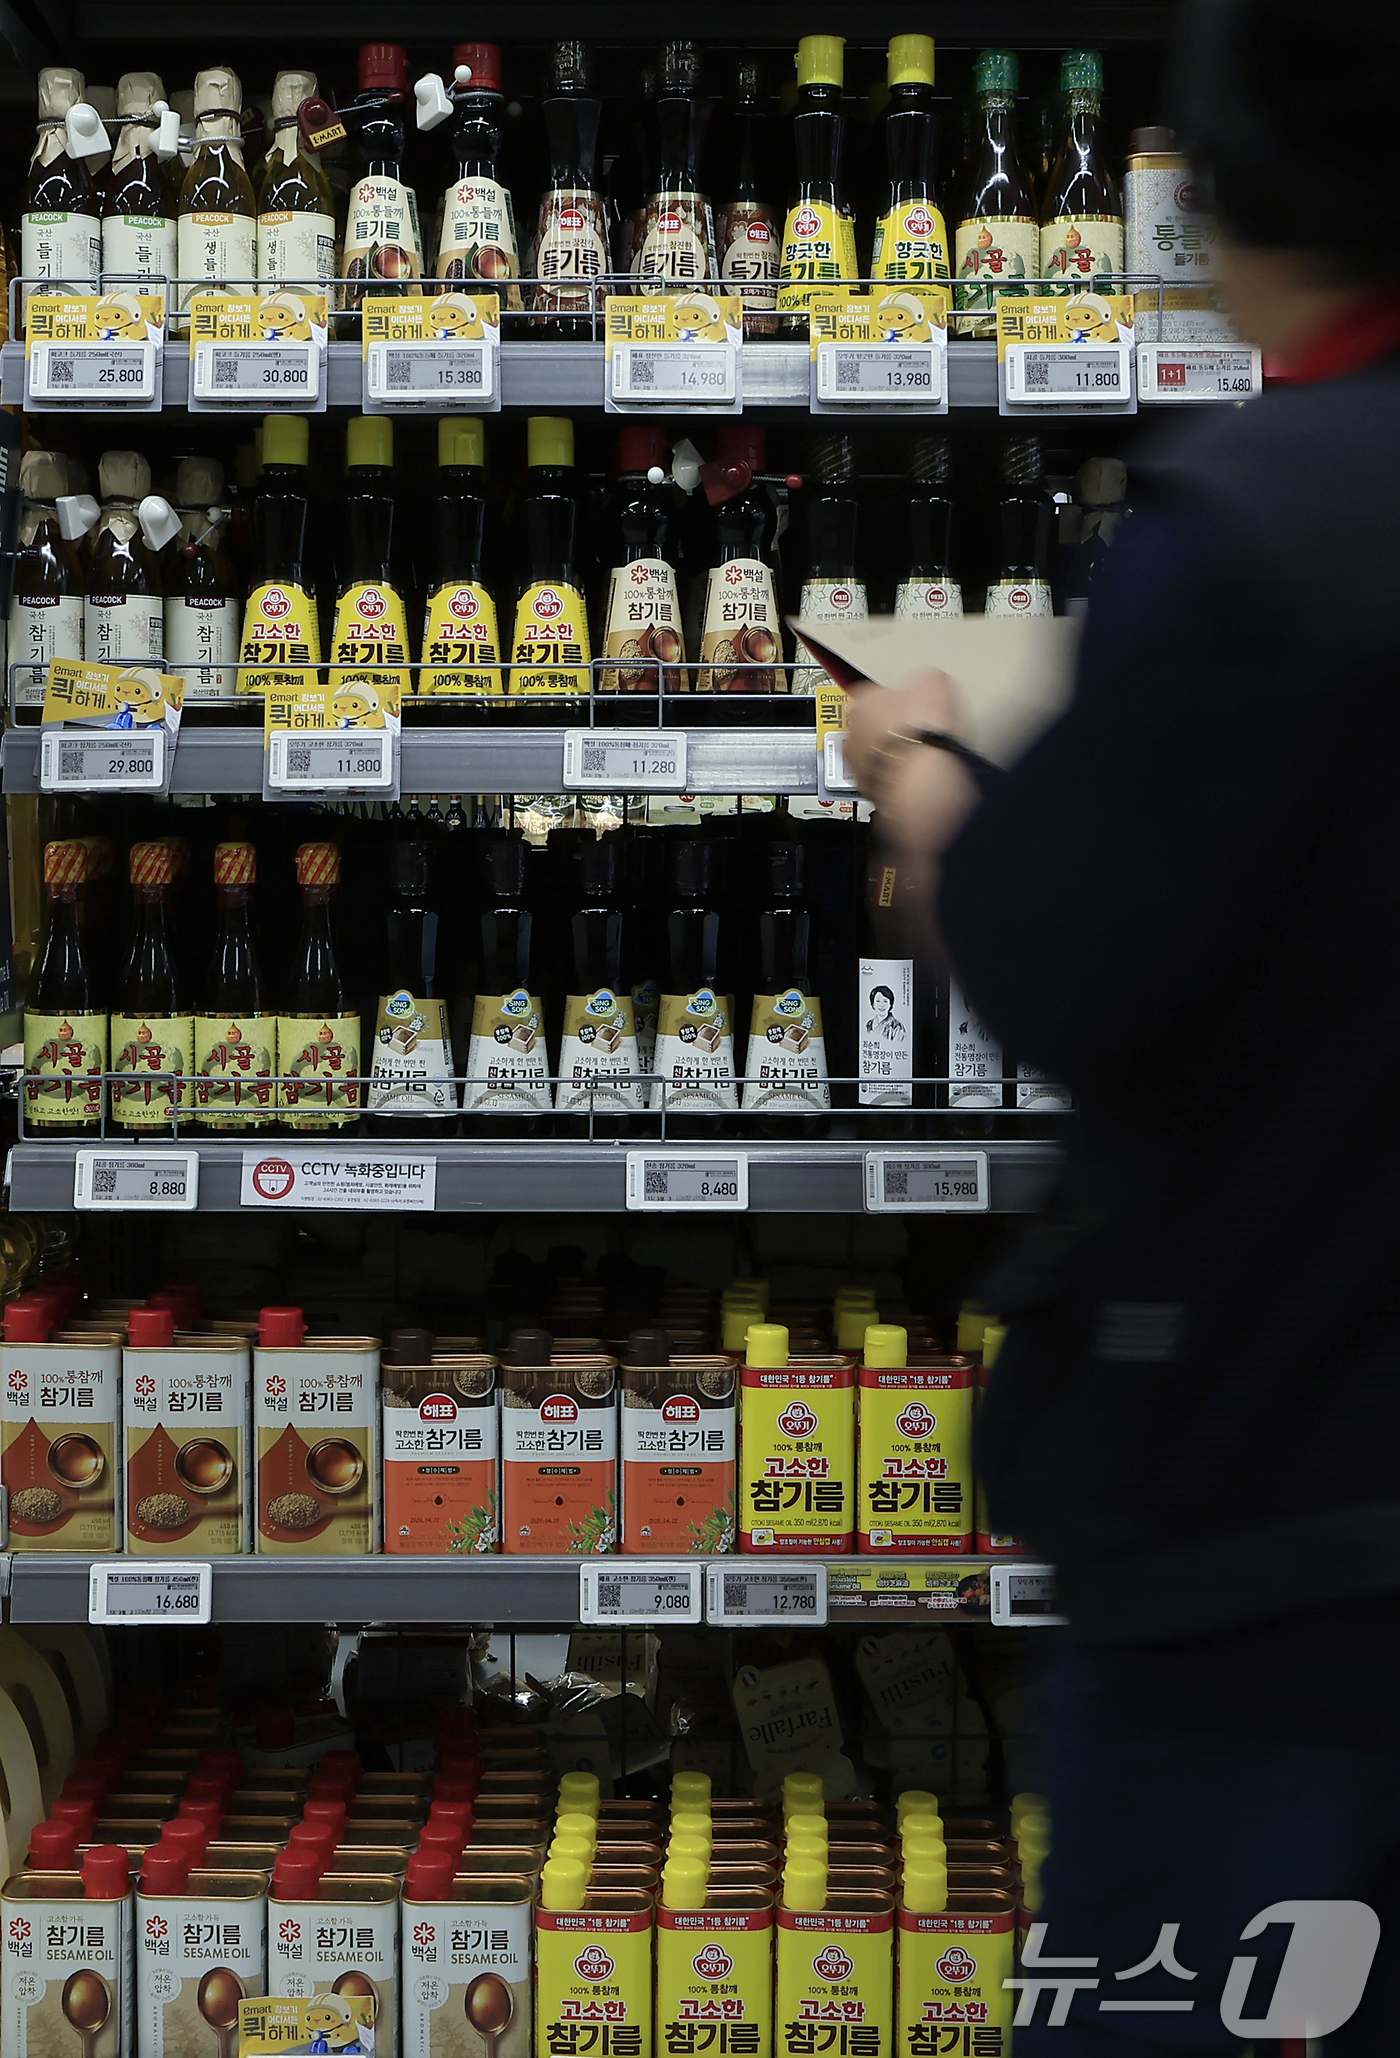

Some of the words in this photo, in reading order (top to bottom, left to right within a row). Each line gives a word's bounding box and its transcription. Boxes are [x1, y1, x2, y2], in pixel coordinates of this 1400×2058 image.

[31, 213, 63, 222] PEACOCK
[128, 216, 162, 227] PEACOCK
[195, 213, 230, 223] PEACOCK
[261, 212, 289, 223] PEACOCK
[560, 216, 583, 229] 해표
[355, 223, 400, 241] 들기름
[453, 221, 499, 240] 들기름
[658, 219, 680, 232] 해표
[749, 227, 769, 240] 해표
[785, 241, 832, 259] 향긋한
[895, 242, 943, 259] 향긋한
[541, 251, 599, 274] 들기름
[642, 252, 700, 274] 들기름
[963, 249, 1008, 272] 시골
[1049, 249, 1096, 272] 시골
[1001, 304, 1030, 314] emart
[1033, 304, 1059, 313] 장보기
[392, 324, 423, 339] 하게
[634, 324, 665, 339] 하게
[839, 324, 871, 339] 하게
[1001, 315, 1024, 339] 퀵
[1025, 315, 1058, 323] 어디서든
[1026, 324, 1058, 339] 하게
[1160, 368, 1182, 380] 1+1
[743, 569, 764, 582] 백설
[22, 595, 56, 606] PEACOCK
[91, 594, 122, 605] PEACOCK
[189, 597, 223, 607] PEACOCK
[96, 610, 113, 619] 국산
[196, 612, 213, 621] 국산
[251, 622, 301, 641] 고소한
[346, 622, 396, 641] 고소한
[438, 622, 488, 641] 고소한
[523, 622, 573, 641] 고소한
[54, 668, 83, 679] emart
[85, 671, 109, 682] 장보기
[432, 675, 461, 687] 100%
[463, 674, 492, 688] 통참깨
[518, 675, 546, 688] 100%
[548, 674, 578, 688] 통참깨
[51, 678, 73, 704] 퀵
[76, 680, 108, 692] 어디서든
[270, 693, 298, 703] emart
[301, 693, 325, 702] 장보기
[75, 691, 107, 709] 하게
[269, 704, 291, 727] 퀵
[293, 704, 325, 712] 어디서든
[294, 712, 325, 727] 하게
[692, 999, 711, 1008] SING
[780, 999, 799, 1007] SING
[783, 1006, 803, 1014] SONG
[37, 1042, 87, 1068] 시골
[119, 1045, 166, 1070] 시골
[207, 1045, 256, 1071] 시골
[296, 1045, 346, 1071] 시골
[895, 1050, 908, 1060] 만든
[260, 1163, 288, 1173] CCTV
[301, 1162, 340, 1176] CCTV
[344, 1163, 426, 1179] 녹화중입니다
[6, 1391, 30, 1406] 백설
[40, 1387, 95, 1408] 참기름
[133, 1396, 157, 1412] 백설
[168, 1392, 223, 1413] 참기름
[264, 1396, 288, 1412] 백설
[299, 1392, 354, 1413] 참기름
[422, 1405, 454, 1419] 해표
[544, 1405, 575, 1419] 해표
[665, 1405, 696, 1420] 해표
[426, 1428, 483, 1450] 참기름
[547, 1429, 604, 1451] 참기름
[668, 1430, 725, 1451] 참기름
[773, 1443, 793, 1452] 100%
[795, 1442, 823, 1453] 통참깨
[891, 1444, 911, 1452] 100%
[913, 1442, 941, 1453] 통참깨
[764, 1457, 830, 1479] 고소한
[882, 1458, 948, 1480] 고소한
[750, 1481, 845, 1512] 참기름
[868, 1481, 964, 1513] 참기름
[748, 1706, 832, 1745] Farfalle
[556, 1917, 586, 1927] 대한민국
[46, 1925, 105, 1946] 참기름
[183, 1924, 242, 1945] 참기름
[316, 1927, 375, 1948] 참기름
[451, 1929, 509, 1951] 참기름
[8, 1941, 33, 1958] 백설
[46, 1950, 93, 1961] SESAME
[95, 1950, 114, 1961] OIL
[144, 1940, 170, 1956] 백설
[183, 1947, 230, 1959] SESAME
[231, 1947, 251, 1959] OIL
[277, 1942, 303, 1959] 백설
[412, 1945, 438, 1962] 백설
[316, 1951, 363, 1962] SESAME
[365, 1951, 384, 1962] OIL
[451, 1953, 498, 1965] SESAME
[499, 1953, 518, 1965] OIL
[582, 1963, 607, 1974] 오뚜기
[701, 1963, 725, 1974] 오뚜기
[820, 1961, 846, 1973] 오뚜기
[944, 1962, 969, 1974] 오뚜기
[154, 1974, 172, 1985] 저온
[421, 1980, 438, 1990] 저온
[155, 1985, 172, 1996] 압착
[421, 1990, 439, 2001] 압착
[807, 1986, 829, 1995] 100%
[831, 1984, 859, 1996] 통참깨
[931, 1989, 951, 1997] 100%
[953, 1987, 982, 1998] 통참깨
[243, 2005, 272, 2016] emart
[274, 2005, 299, 2015] 장보기
[561, 1999, 626, 2022] 고소한
[678, 1999, 744, 2022] 고소한
[799, 1999, 865, 2022] 고소한
[922, 2000, 988, 2023] 고소한
[243, 2017, 265, 2041] 퀵
[267, 2016, 299, 2025] 어디서든
[268, 2025, 298, 2041] 하게
